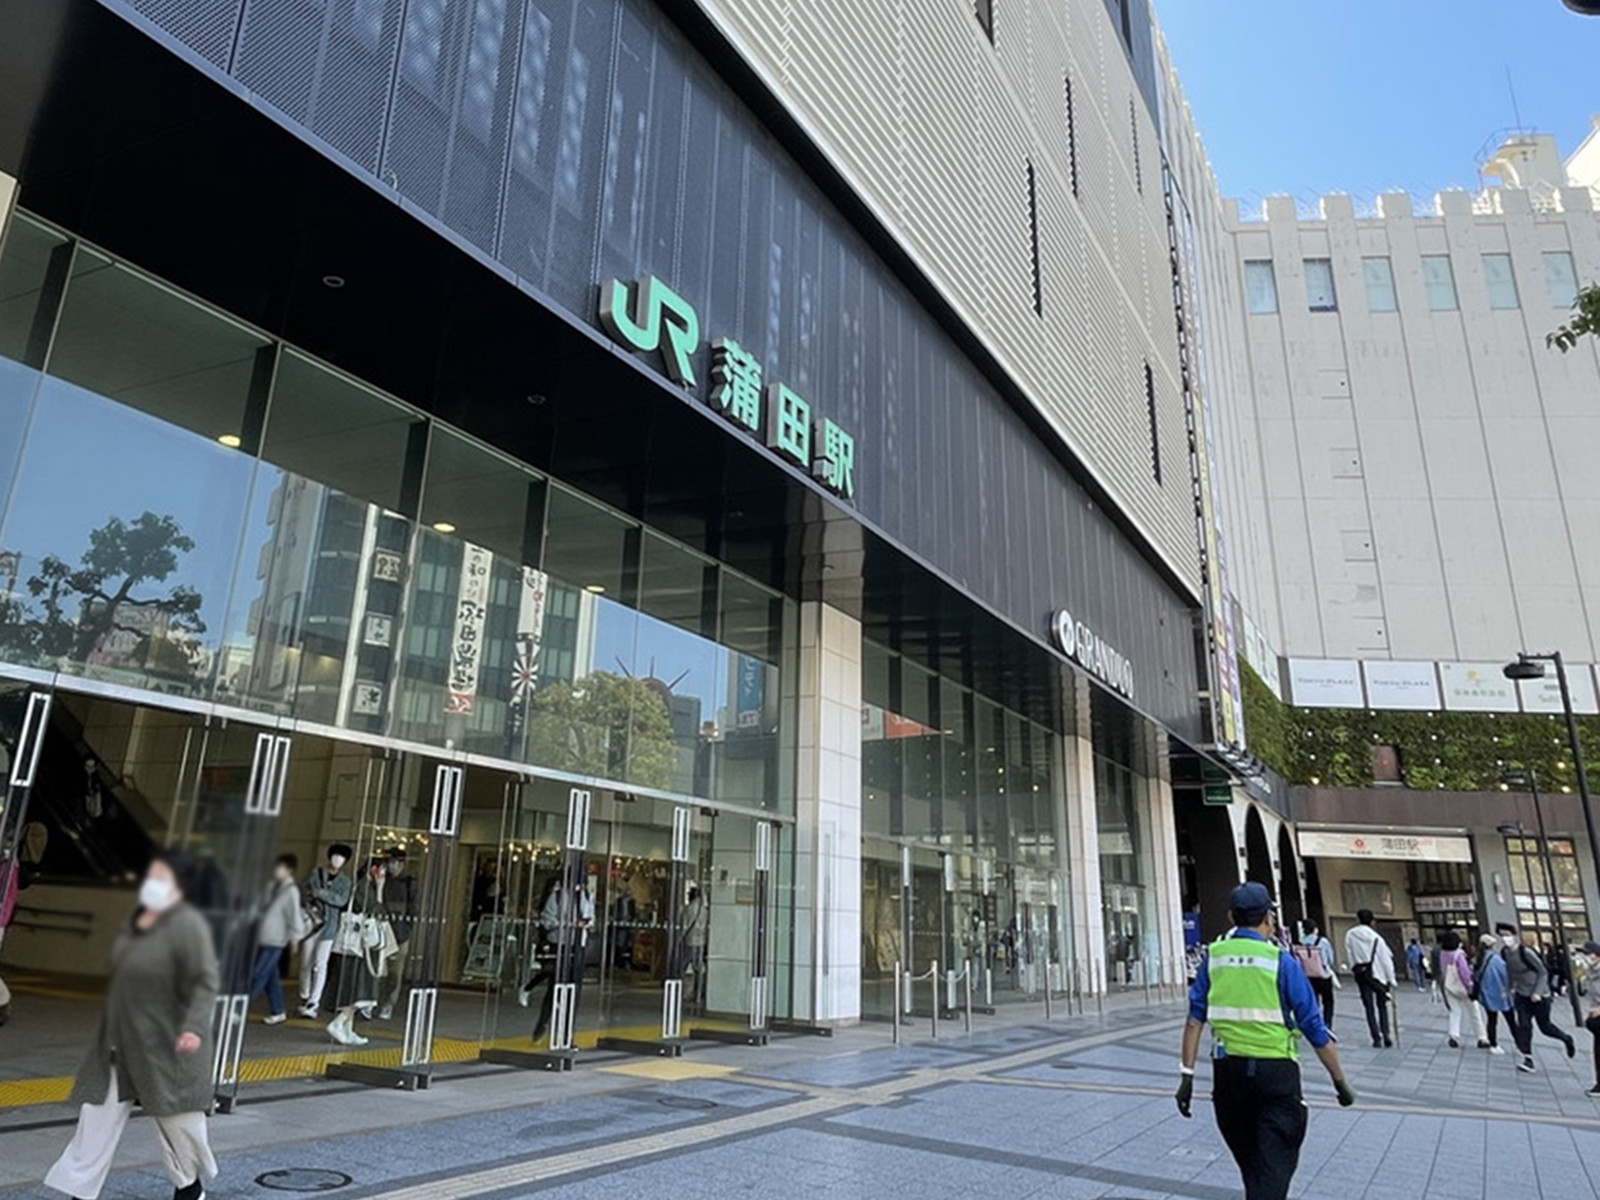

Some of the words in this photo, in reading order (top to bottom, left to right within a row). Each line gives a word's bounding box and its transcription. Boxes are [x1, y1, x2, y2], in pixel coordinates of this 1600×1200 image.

[602, 274, 700, 388] JR
[713, 336, 855, 499] 蒲田駅
